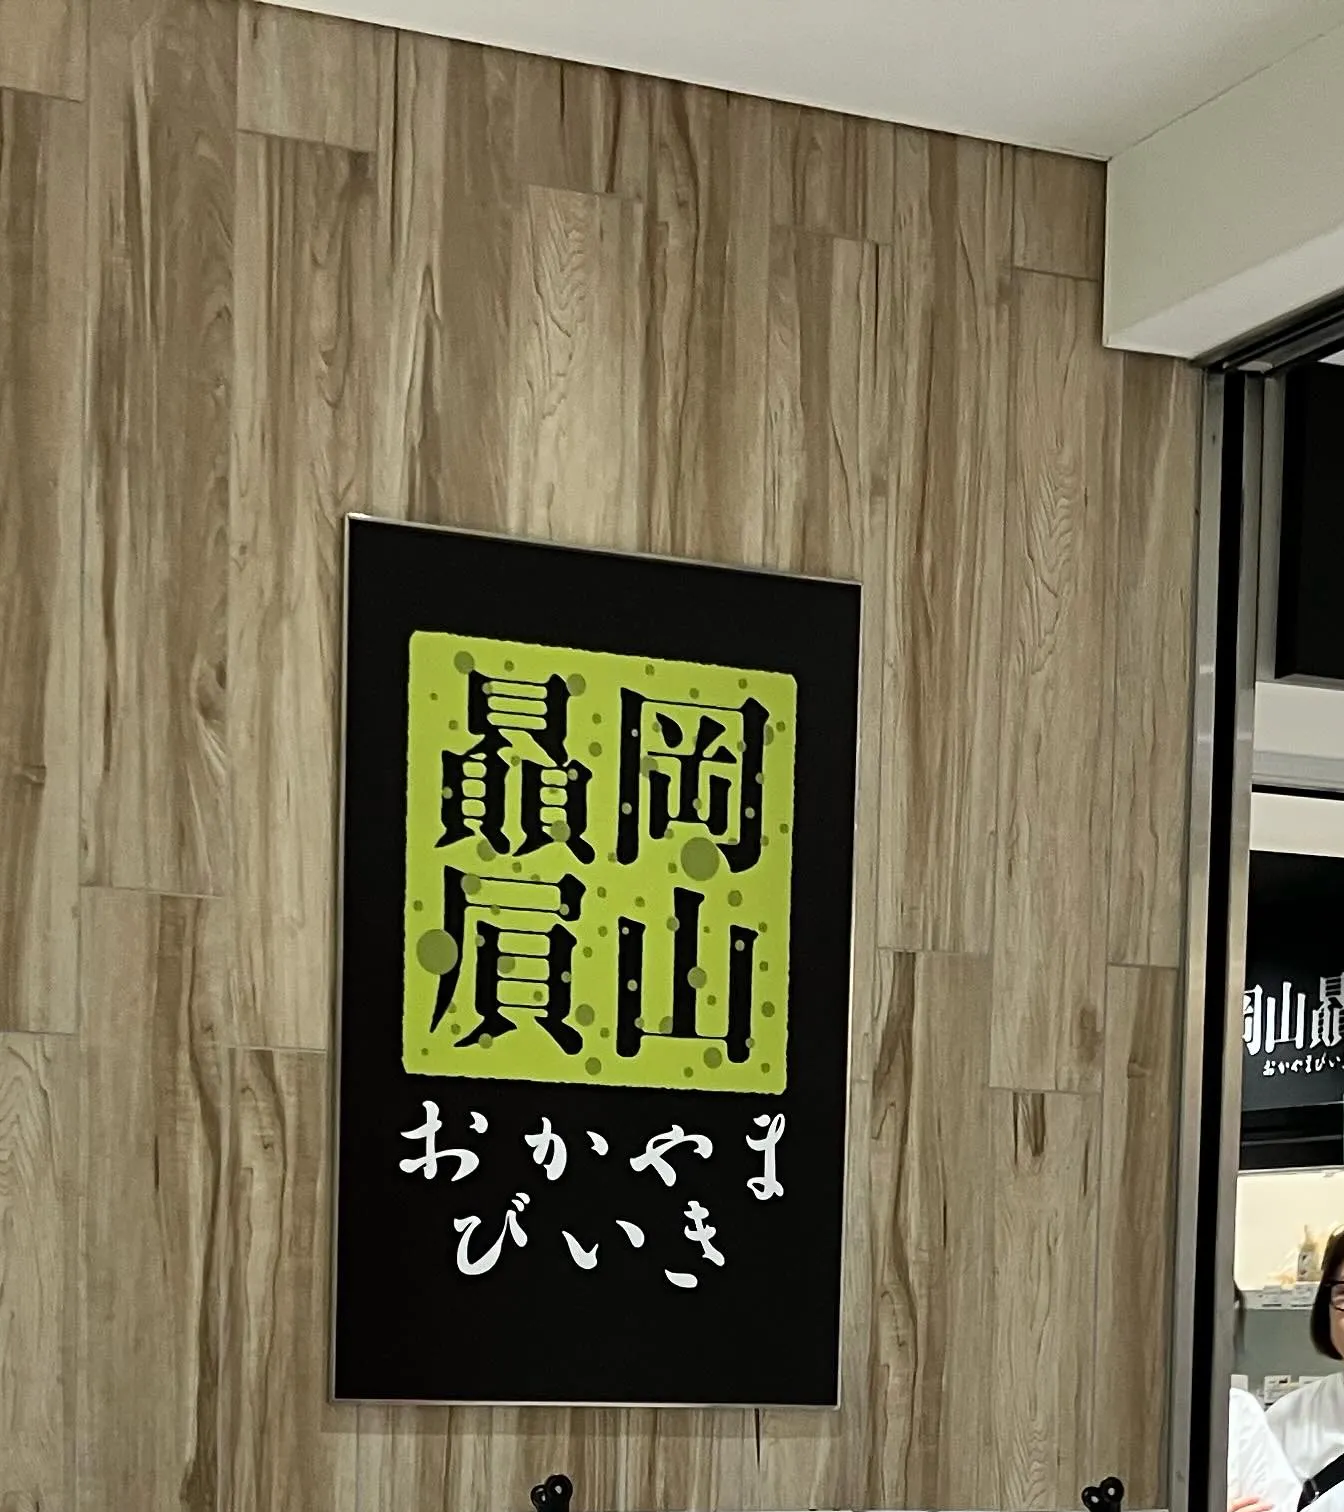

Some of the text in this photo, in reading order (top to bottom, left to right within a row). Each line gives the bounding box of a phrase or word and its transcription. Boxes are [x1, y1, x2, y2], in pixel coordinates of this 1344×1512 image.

[399, 1098, 786, 1200] おかやま
[453, 1192, 726, 1288] びいき
